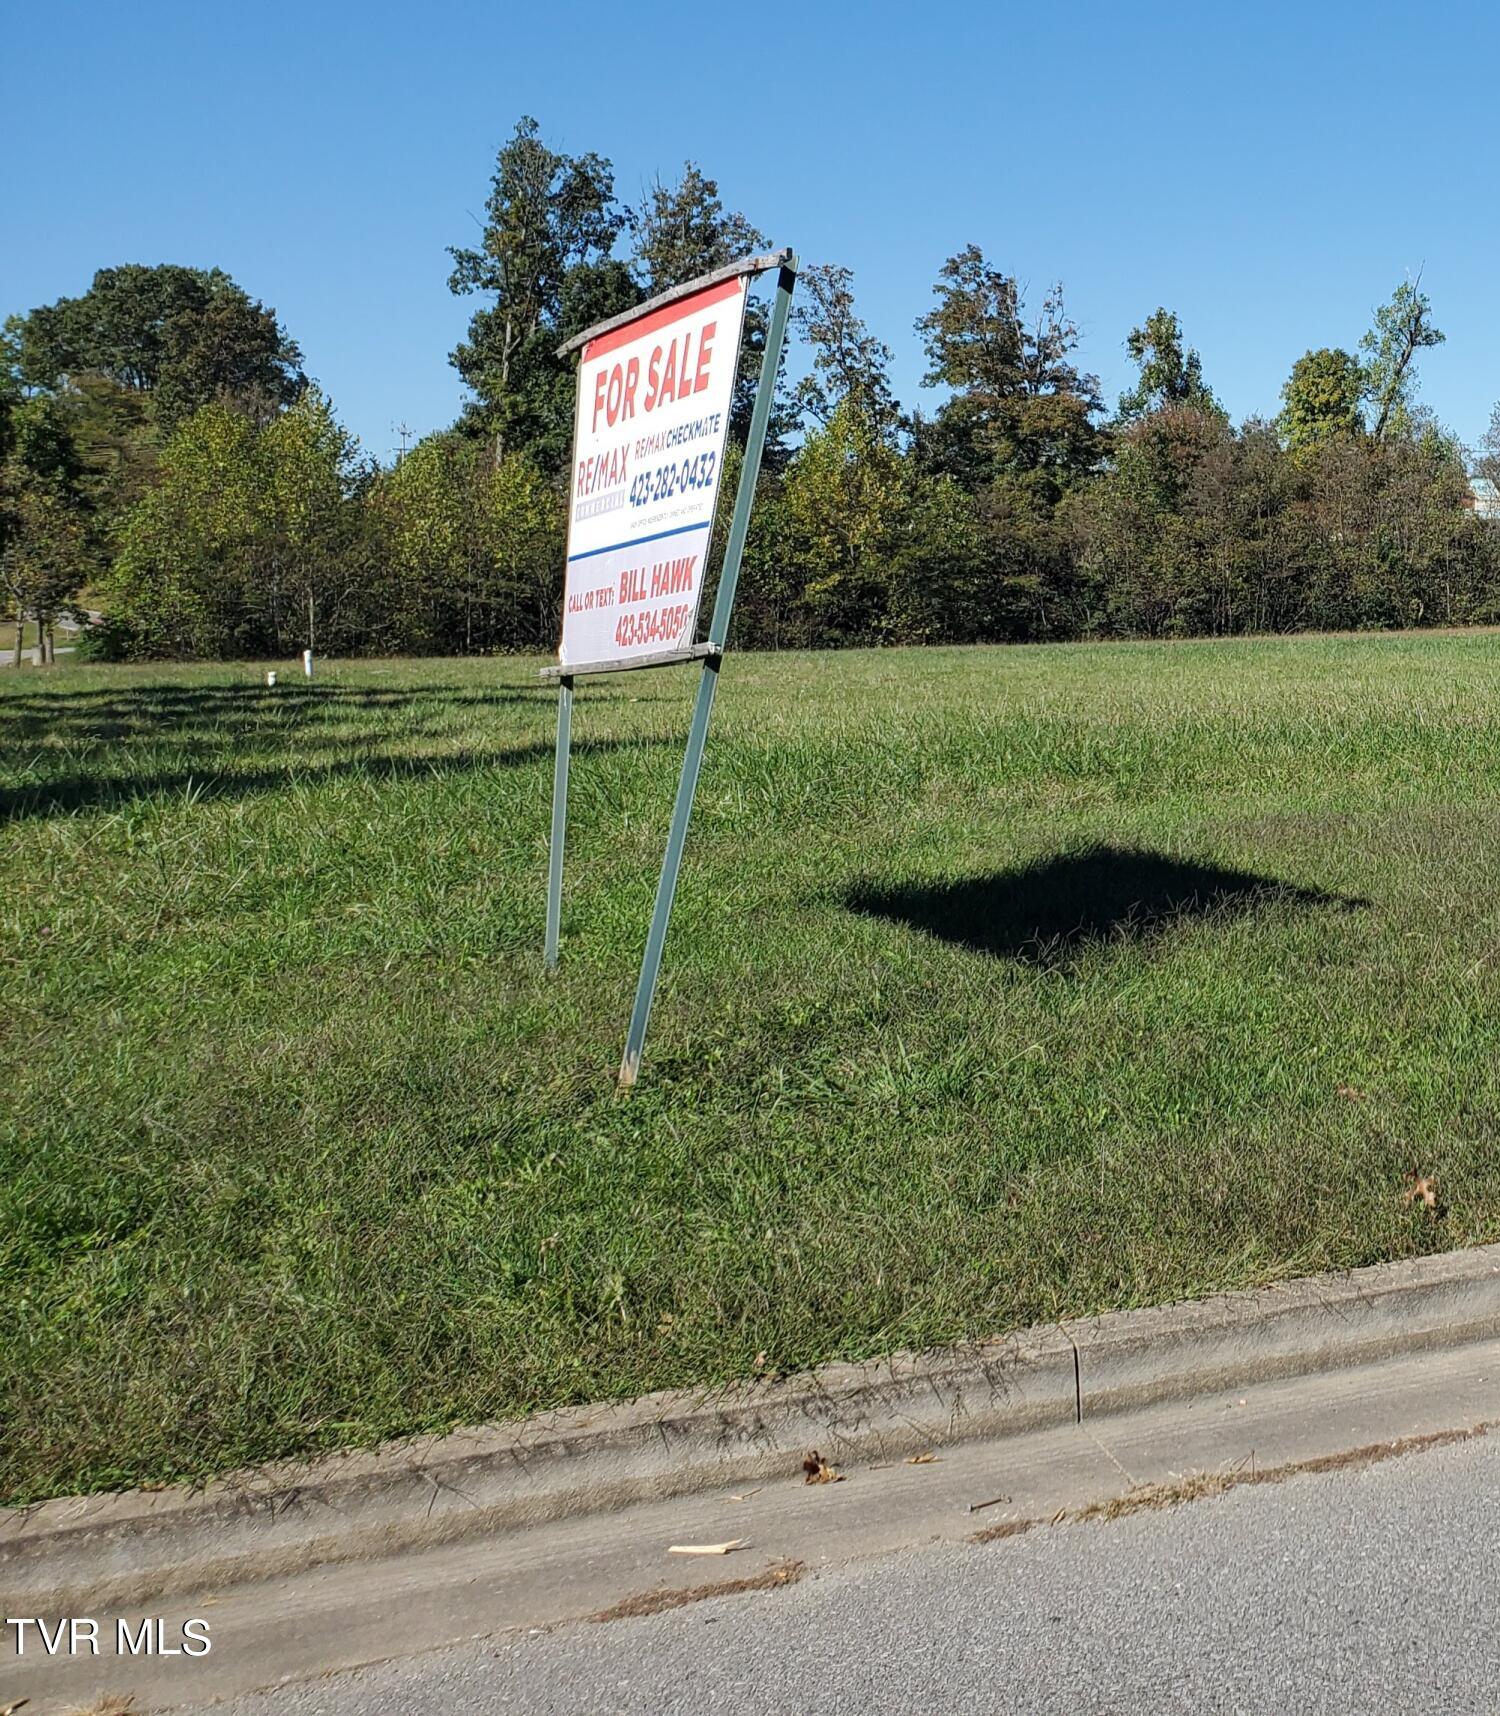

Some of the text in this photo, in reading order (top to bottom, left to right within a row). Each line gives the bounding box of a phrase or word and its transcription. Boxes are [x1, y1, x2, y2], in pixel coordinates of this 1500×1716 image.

[592, 321, 717, 434] FOR SALE
[577, 443, 630, 498] RE/MAX
[629, 450, 716, 508] 423-282-0432
[568, 592, 583, 613] CALL
[585, 590, 594, 610] OR
[619, 567, 647, 604] BILL
[650, 555, 698, 598] HAWK
